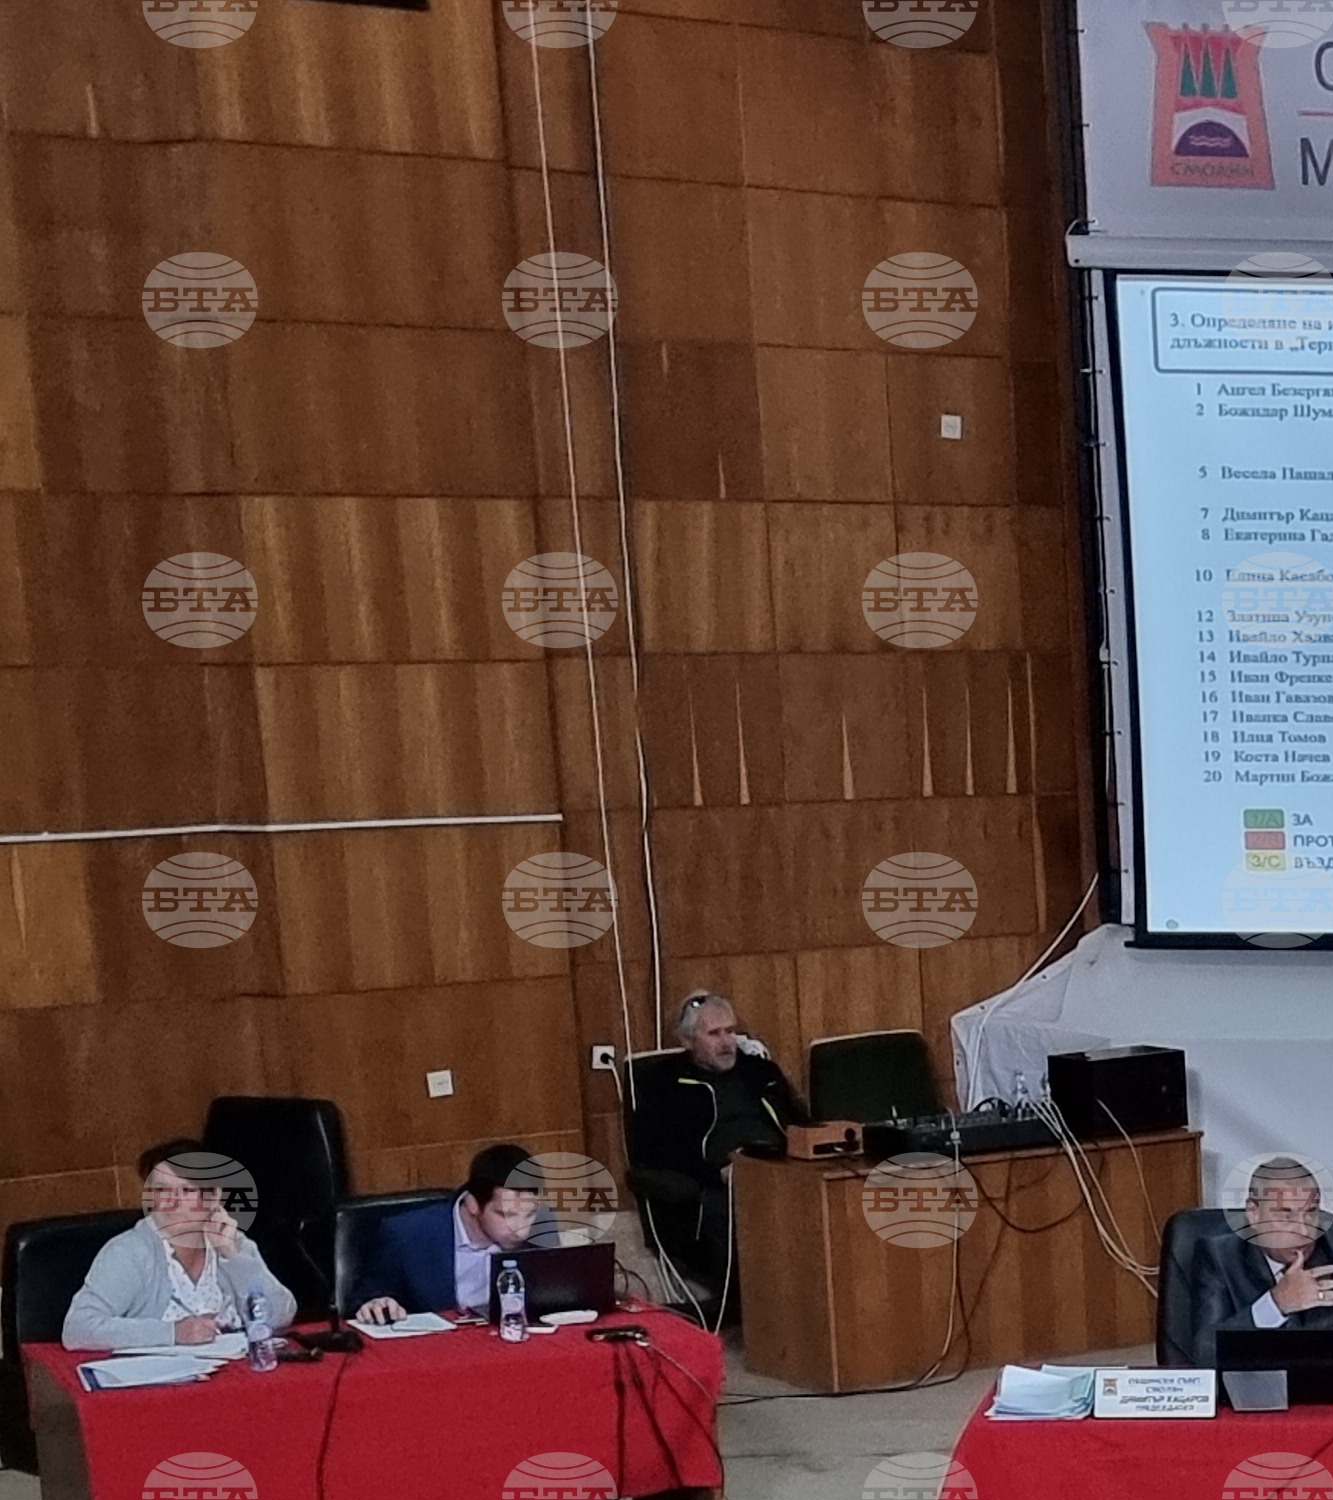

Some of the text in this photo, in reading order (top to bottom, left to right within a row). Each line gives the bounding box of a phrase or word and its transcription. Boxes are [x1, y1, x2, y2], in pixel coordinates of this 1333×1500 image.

[1302, 318, 1322, 331] на
[1274, 340, 1284, 350] в
[1196, 383, 1203, 396] 1
[1217, 383, 1266, 397] Ангел
[1196, 404, 1204, 416] 2
[1218, 404, 1288, 421] Божидар
[1199, 466, 1208, 479] 5
[1221, 466, 1276, 480] Весела
[1201, 508, 1209, 520] 7
[1221, 508, 1295, 524] Димитър
[1202, 529, 1210, 541] 8
[1195, 570, 1213, 582] 10
[1197, 610, 1214, 623] 12
[1198, 630, 1215, 642] 13
[1199, 650, 1216, 663] 14
[1229, 650, 1288, 664] Ивайло
[1199, 671, 1217, 683] 15
[1230, 671, 1270, 684] Иван
[1200, 691, 1218, 703] 16
[1231, 691, 1270, 704] Иван
[1202, 711, 1218, 723] 17
[1203, 731, 1219, 743] 18
[1204, 751, 1221, 763] 19
[1233, 751, 1279, 763] Коста
[1204, 771, 1222, 783] 20
[1235, 771, 1296, 786] Мартин
[1292, 813, 1313, 826] ЗА
